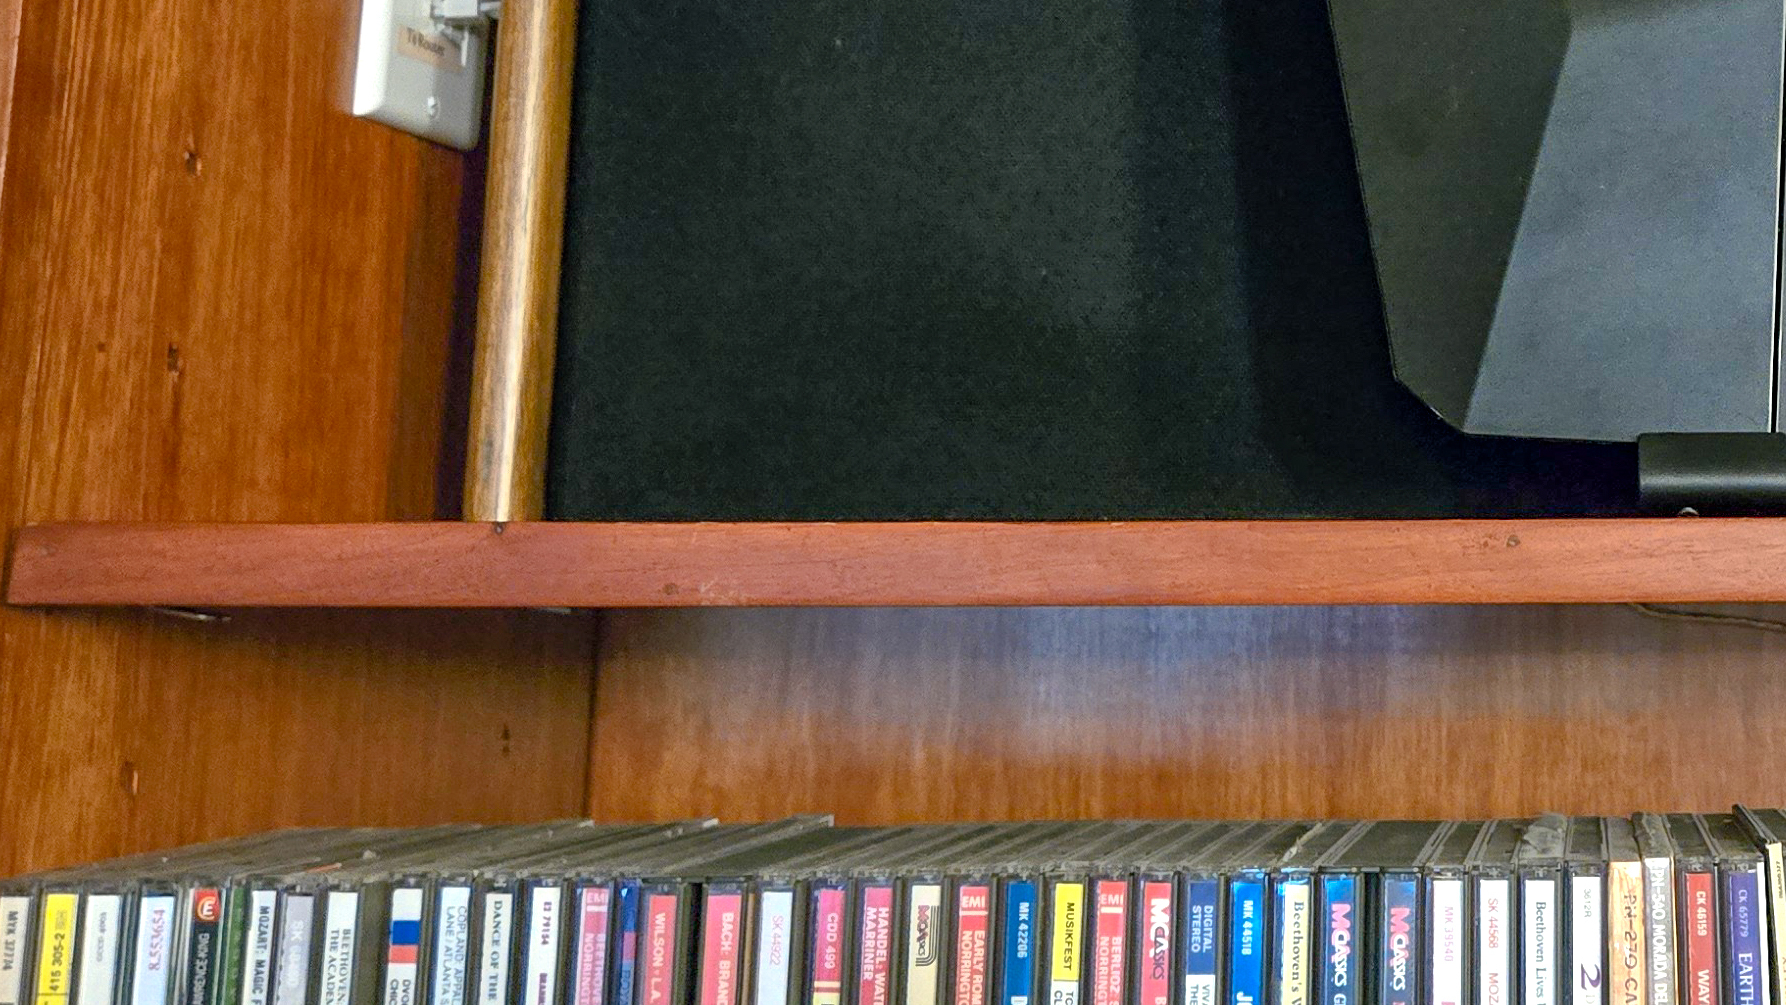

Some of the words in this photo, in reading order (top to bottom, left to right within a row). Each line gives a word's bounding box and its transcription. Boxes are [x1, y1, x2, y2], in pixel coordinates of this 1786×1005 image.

[961, 895, 986, 908] EMI
[1018, 901, 1029, 922] MK
[1099, 893, 1124, 906] EMI
[1243, 900, 1254, 919] MK
[1488, 898, 1499, 913] SK
[1696, 890, 1706, 905] CK
[1738, 889, 1748, 903] CK
[256, 905, 271, 954] MOZART:
[445, 906, 456, 938] LANE
[490, 900, 504, 947] DANCE
[772, 915, 784, 930] SK
[1149, 898, 1170, 958] MCA
[1190, 905, 1202, 953] STEREO
[1202, 905, 1214, 954] DIGITAL
[1444, 906, 1454, 924] MK
[1487, 915, 1499, 949] 44568
[1535, 901, 1547, 963] Beethoven
[1738, 905, 1749, 937] 65779
[51, 932, 66, 967] 305-2
[329, 928, 340, 953] THE
[454, 905, 468, 964] COPLAND:
[652, 912, 667, 967] WILSON
[720, 912, 734, 955] BACH:
[863, 906, 877, 981] MARRINER
[876, 906, 890, 969] HANDEL:
[972, 930, 986, 970] EARLY
[1063, 901, 1076, 972] MUSIKFEST
[1291, 901, 1305, 993] Beethoven's
[489, 951, 501, 970] OF
[824, 945, 837, 970] 499
[1152, 926, 1167, 981] CLASSICS
[1333, 930, 1348, 988] CLASSICS
[1392, 934, 1407, 991] CLASSICS
[1653, 924, 1668, 980] MORADA
[49, 969, 61, 992] 415
[252, 959, 266, 995] MAGIC
[441, 945, 454, 995] ATLANTA
[487, 974, 498, 1001] THE
[1536, 968, 1547, 998] Lives
[1580, 963, 1601, 990] 2
[400, 979, 412, 1005] DVO
